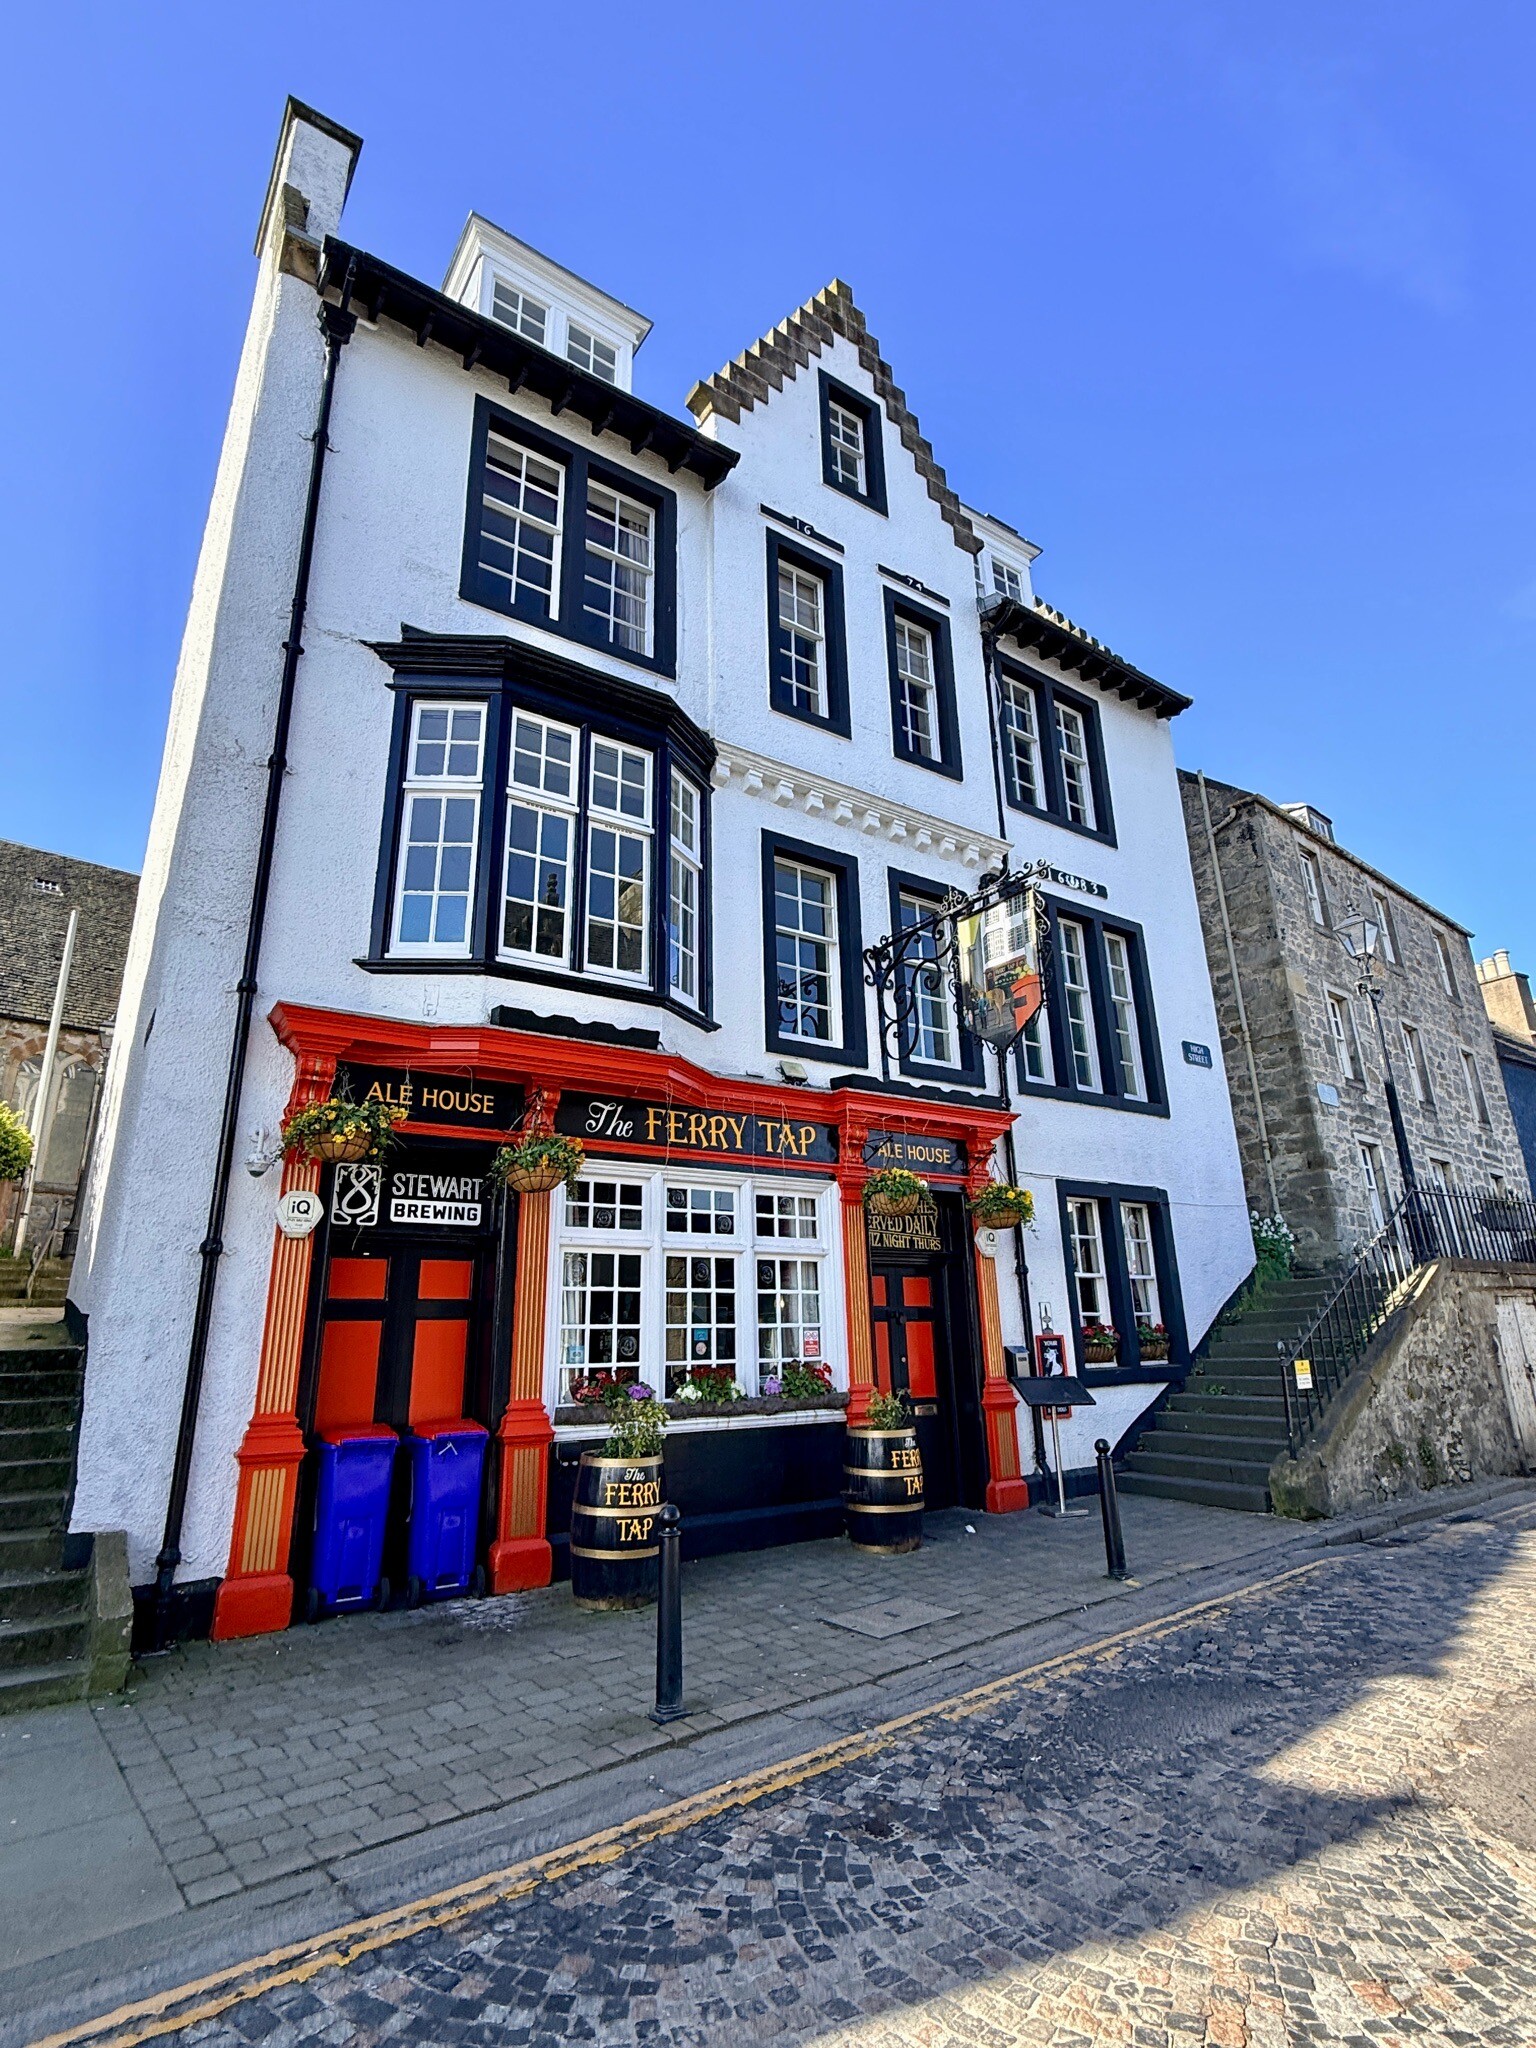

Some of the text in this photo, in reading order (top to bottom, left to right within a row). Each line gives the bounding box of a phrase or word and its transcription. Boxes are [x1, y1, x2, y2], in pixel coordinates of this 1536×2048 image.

[1187, 1052, 1209, 1065] STREET
[365, 1081, 495, 1114] ALE HOUSE
[584, 1101, 816, 1156] The FERRY TAP
[877, 1141, 951, 1164] ALE HOUSE
[391, 1172, 483, 1201] STEWART
[291, 1200, 311, 1216] iQ
[393, 1203, 479, 1223] BREWING
[867, 1215, 939, 1237] ERVED DAILY
[869, 1232, 942, 1251] IZ NIGHT THURS
[891, 1447, 922, 1469] FERR
[624, 1467, 646, 1481] The
[604, 1477, 661, 1507] FERRY
[616, 1517, 653, 1542] TAP
